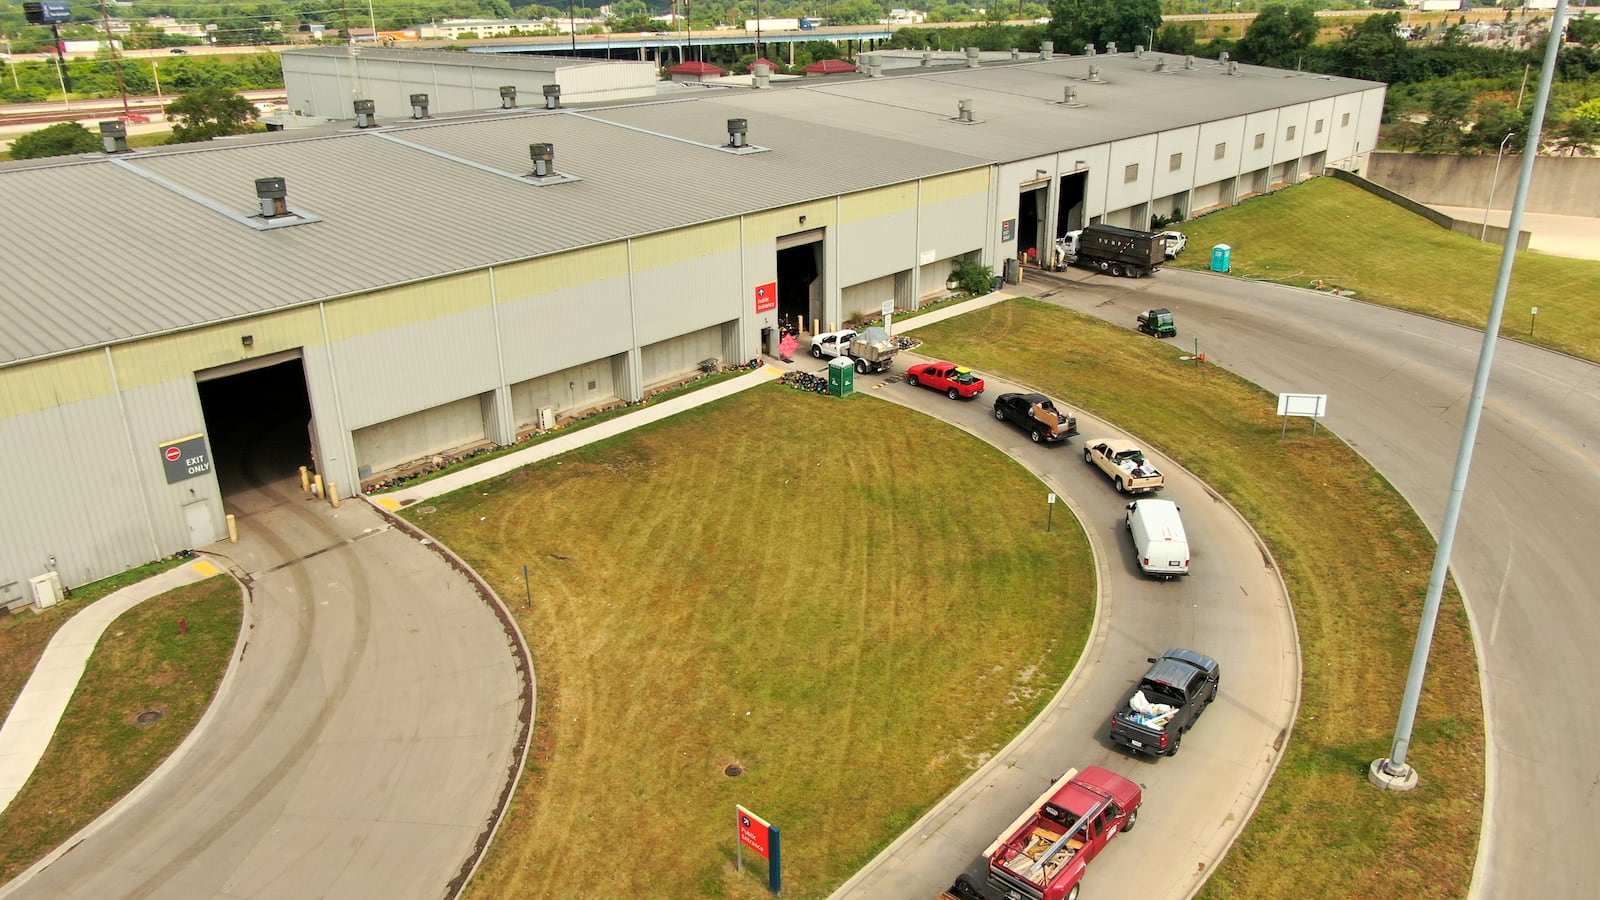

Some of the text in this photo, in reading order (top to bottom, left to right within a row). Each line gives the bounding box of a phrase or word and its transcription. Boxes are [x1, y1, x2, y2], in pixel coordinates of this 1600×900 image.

[186, 455, 204, 466] EXIT
[188, 463, 209, 474] ONLY
[741, 826, 757, 841] Public
[741, 833, 764, 852] Entrance
